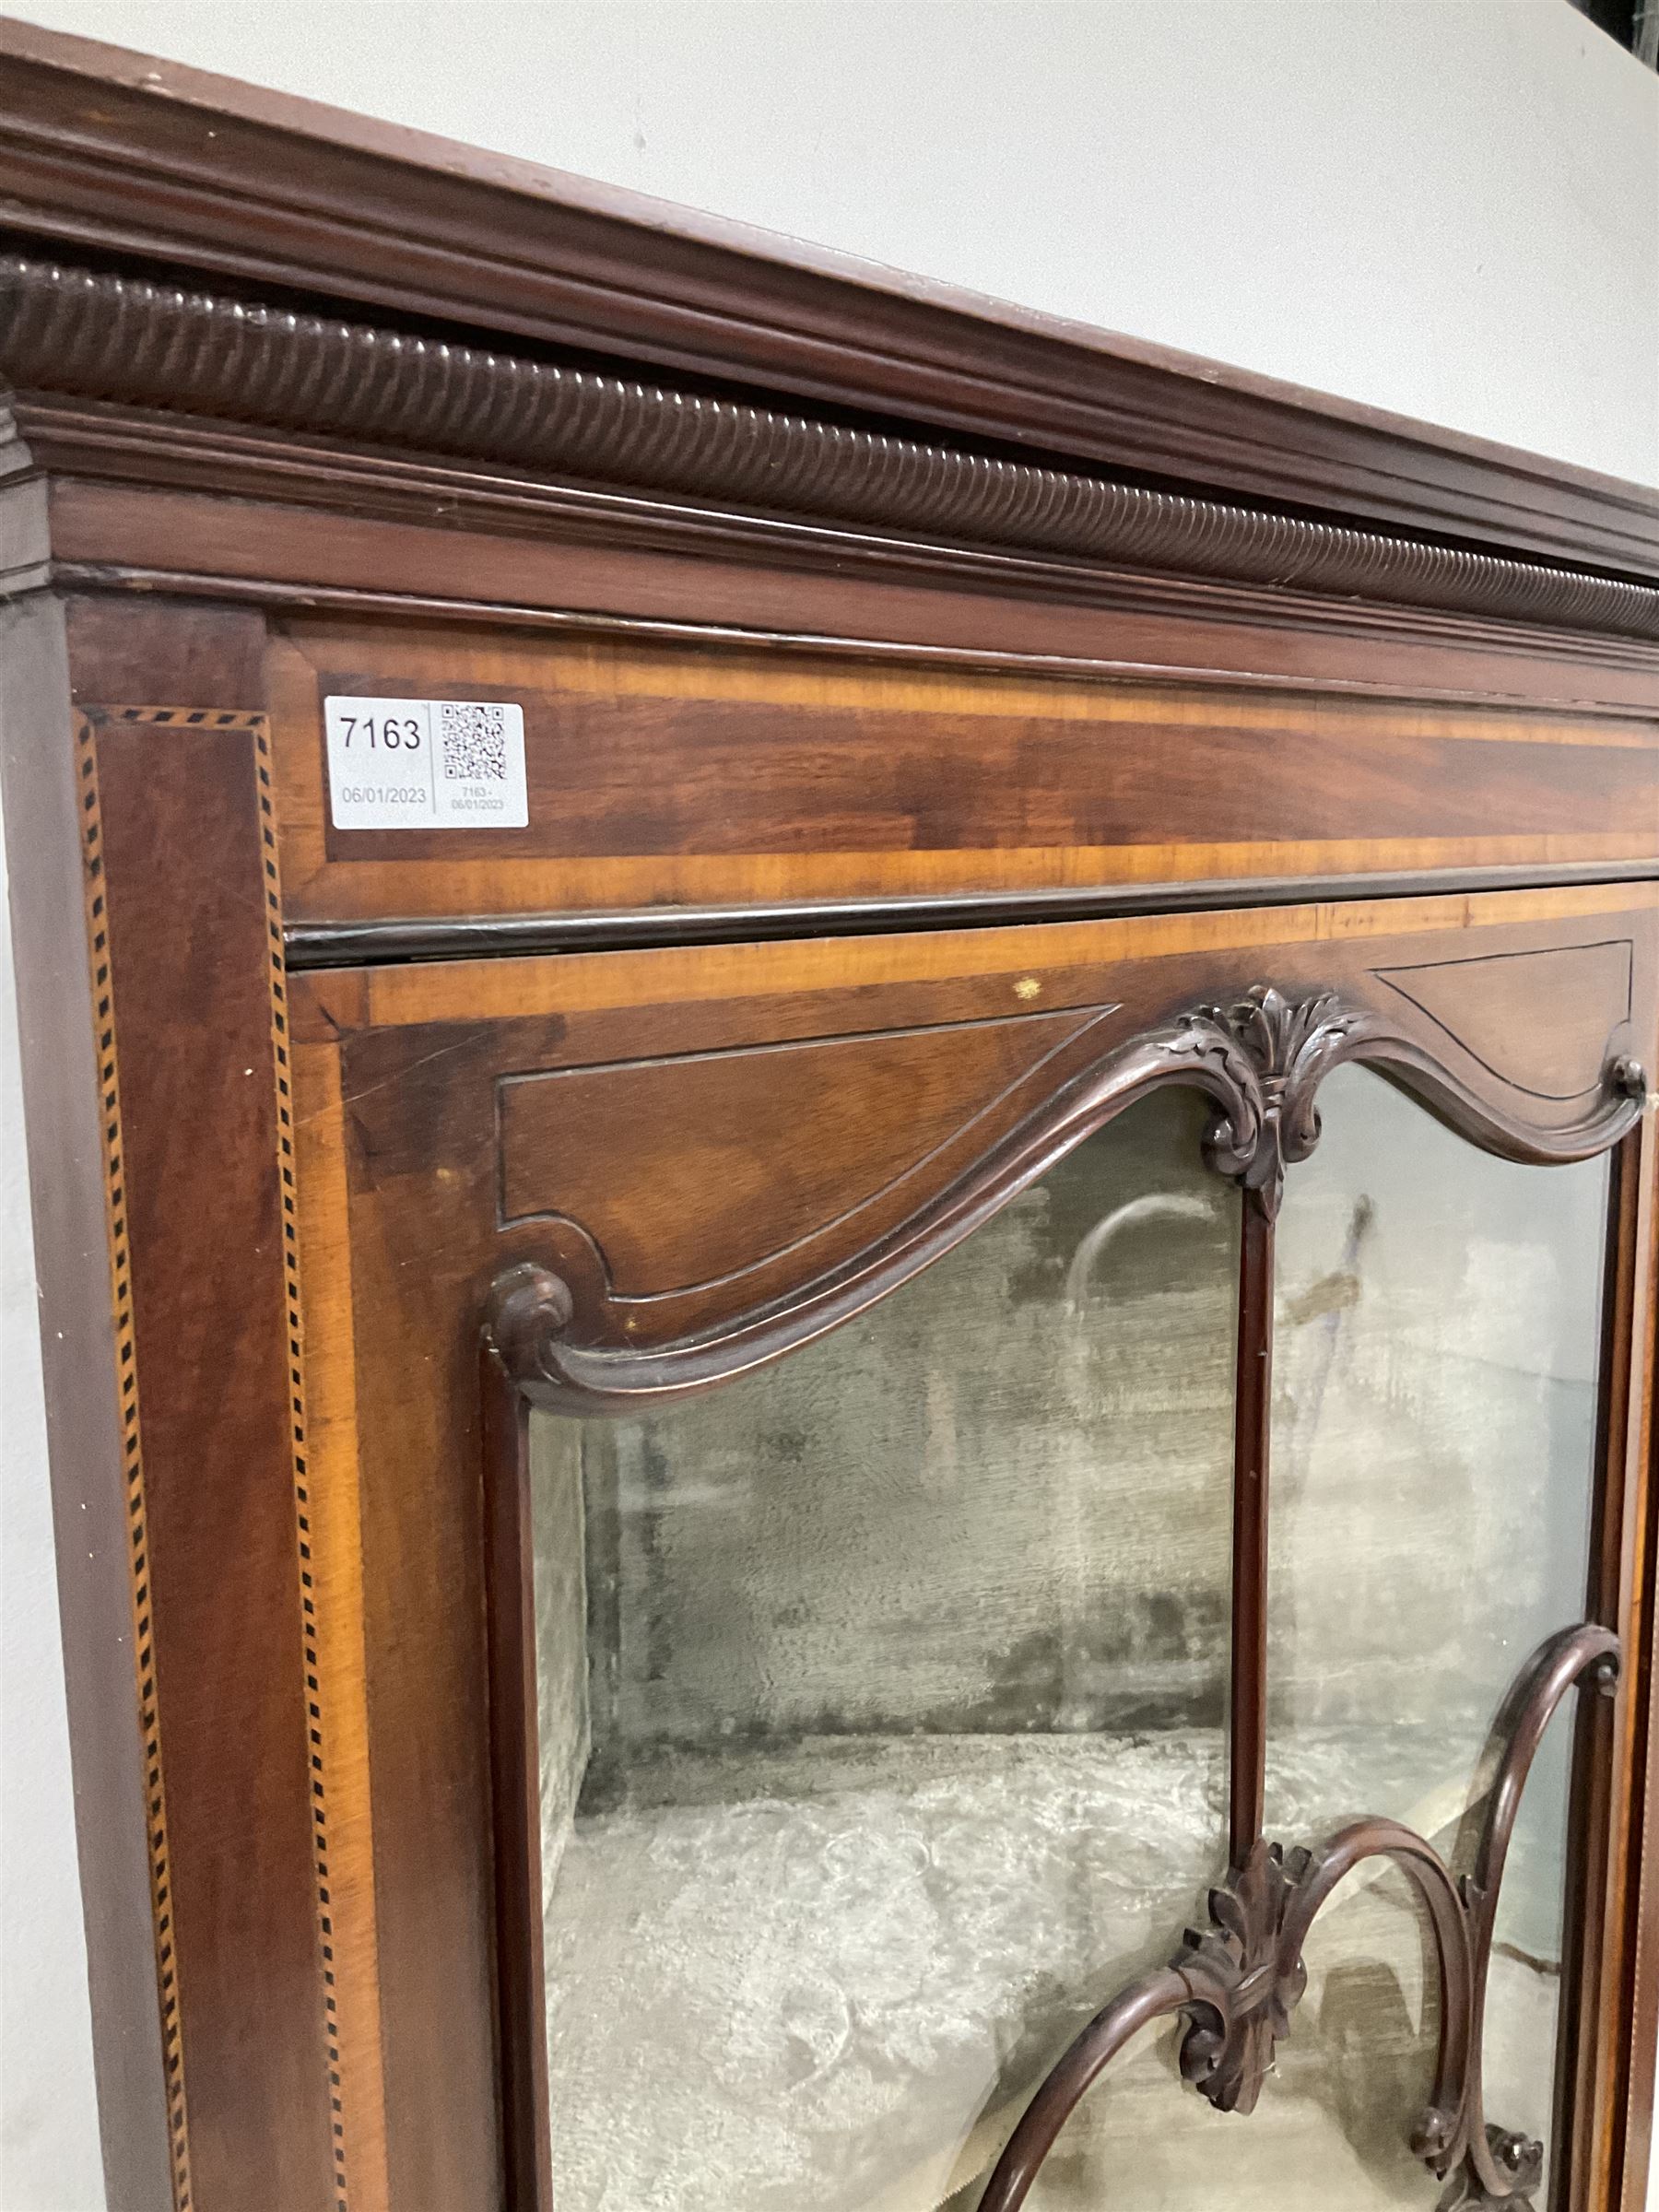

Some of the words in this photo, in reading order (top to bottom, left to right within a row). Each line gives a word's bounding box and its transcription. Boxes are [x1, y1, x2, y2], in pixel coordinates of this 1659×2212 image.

[340, 717, 420, 749] 7163
[342, 787, 427, 803] 06/01/2023
[462, 787, 487, 797] 7163
[452, 799, 504, 809] 06/01/2023
